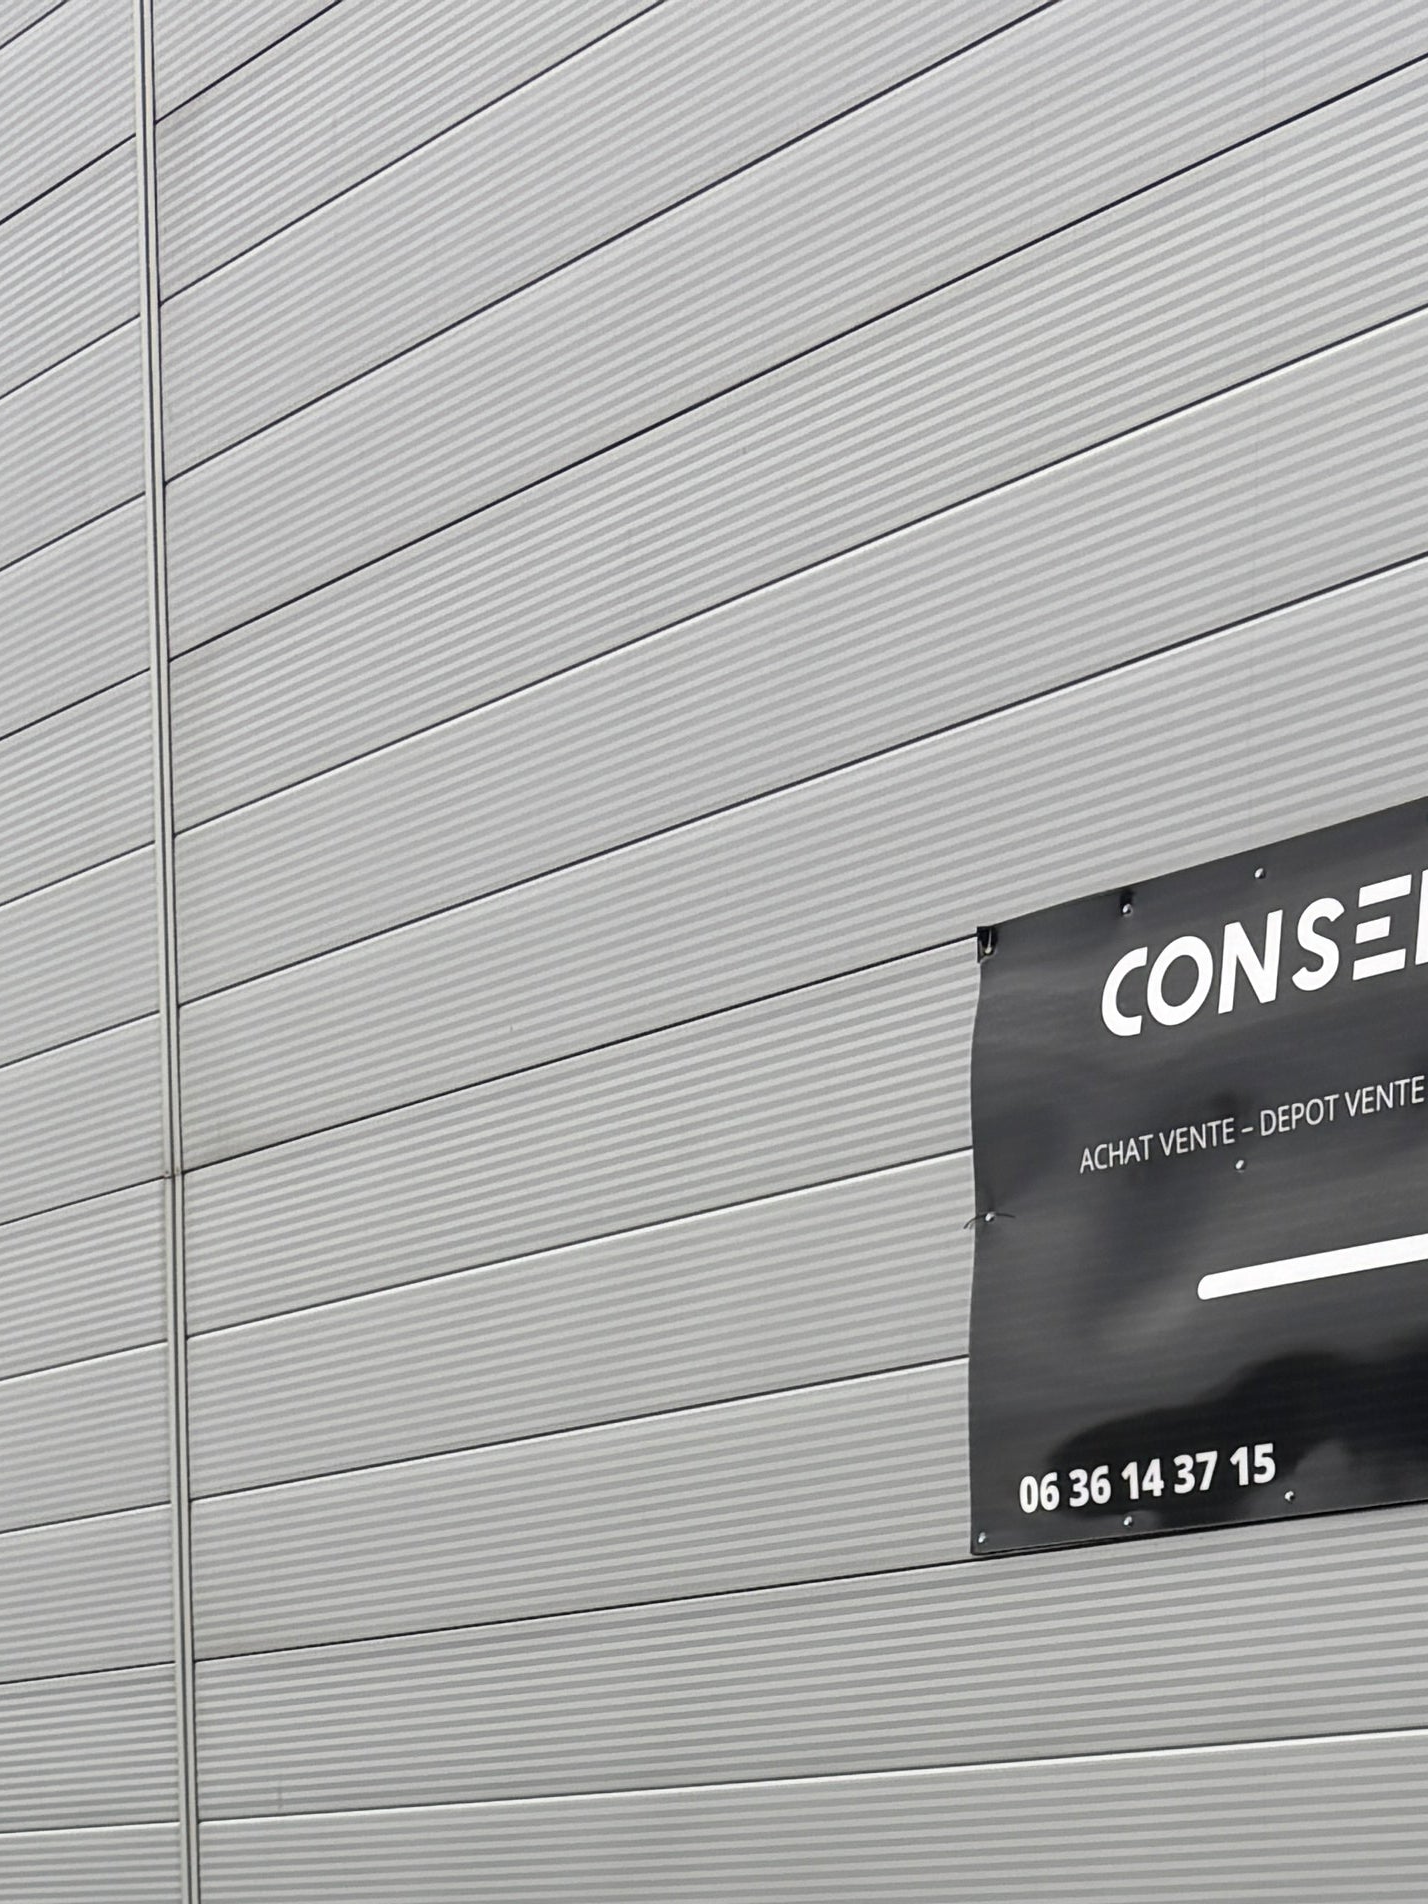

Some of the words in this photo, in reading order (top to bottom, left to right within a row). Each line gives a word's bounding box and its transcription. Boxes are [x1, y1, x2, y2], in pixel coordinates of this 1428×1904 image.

[1079, 1134, 1154, 1174] ACHAT
[1158, 1117, 1235, 1156] VENTE
[1260, 1093, 1340, 1137] DEPOT
[1344, 1075, 1425, 1117] VENTE
[1019, 1471, 1060, 1514] 06
[1069, 1465, 1111, 1507] 36
[1121, 1458, 1165, 1500] 14
[1173, 1450, 1218, 1494] 37
[1229, 1443, 1276, 1486] 15
